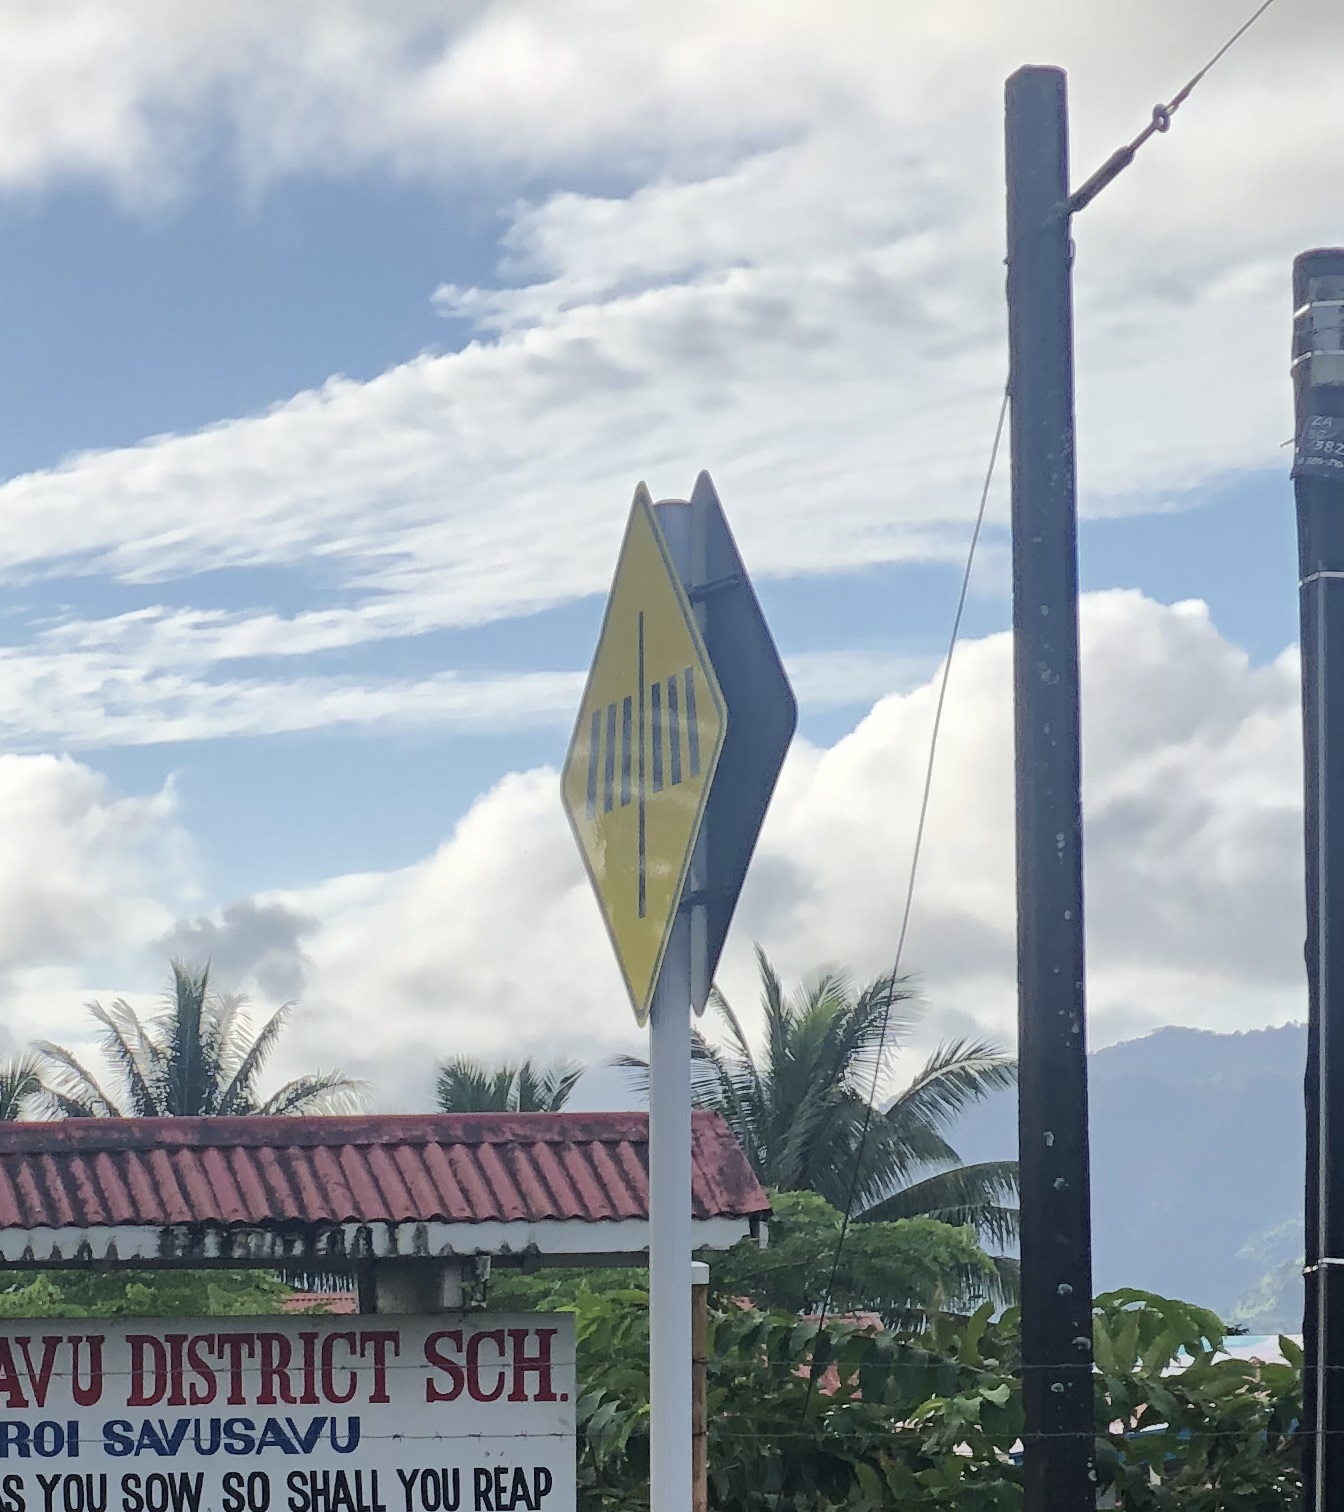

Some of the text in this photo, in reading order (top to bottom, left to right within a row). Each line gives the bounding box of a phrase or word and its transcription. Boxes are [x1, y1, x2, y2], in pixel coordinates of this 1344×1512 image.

[126, 1331, 401, 1407] DISTRICT
[423, 1328, 569, 1403] SCH.
[102, 1416, 361, 1457] SAVUSAVU
[395, 1468, 459, 1512] YOU
[474, 1466, 553, 1512] REAP
